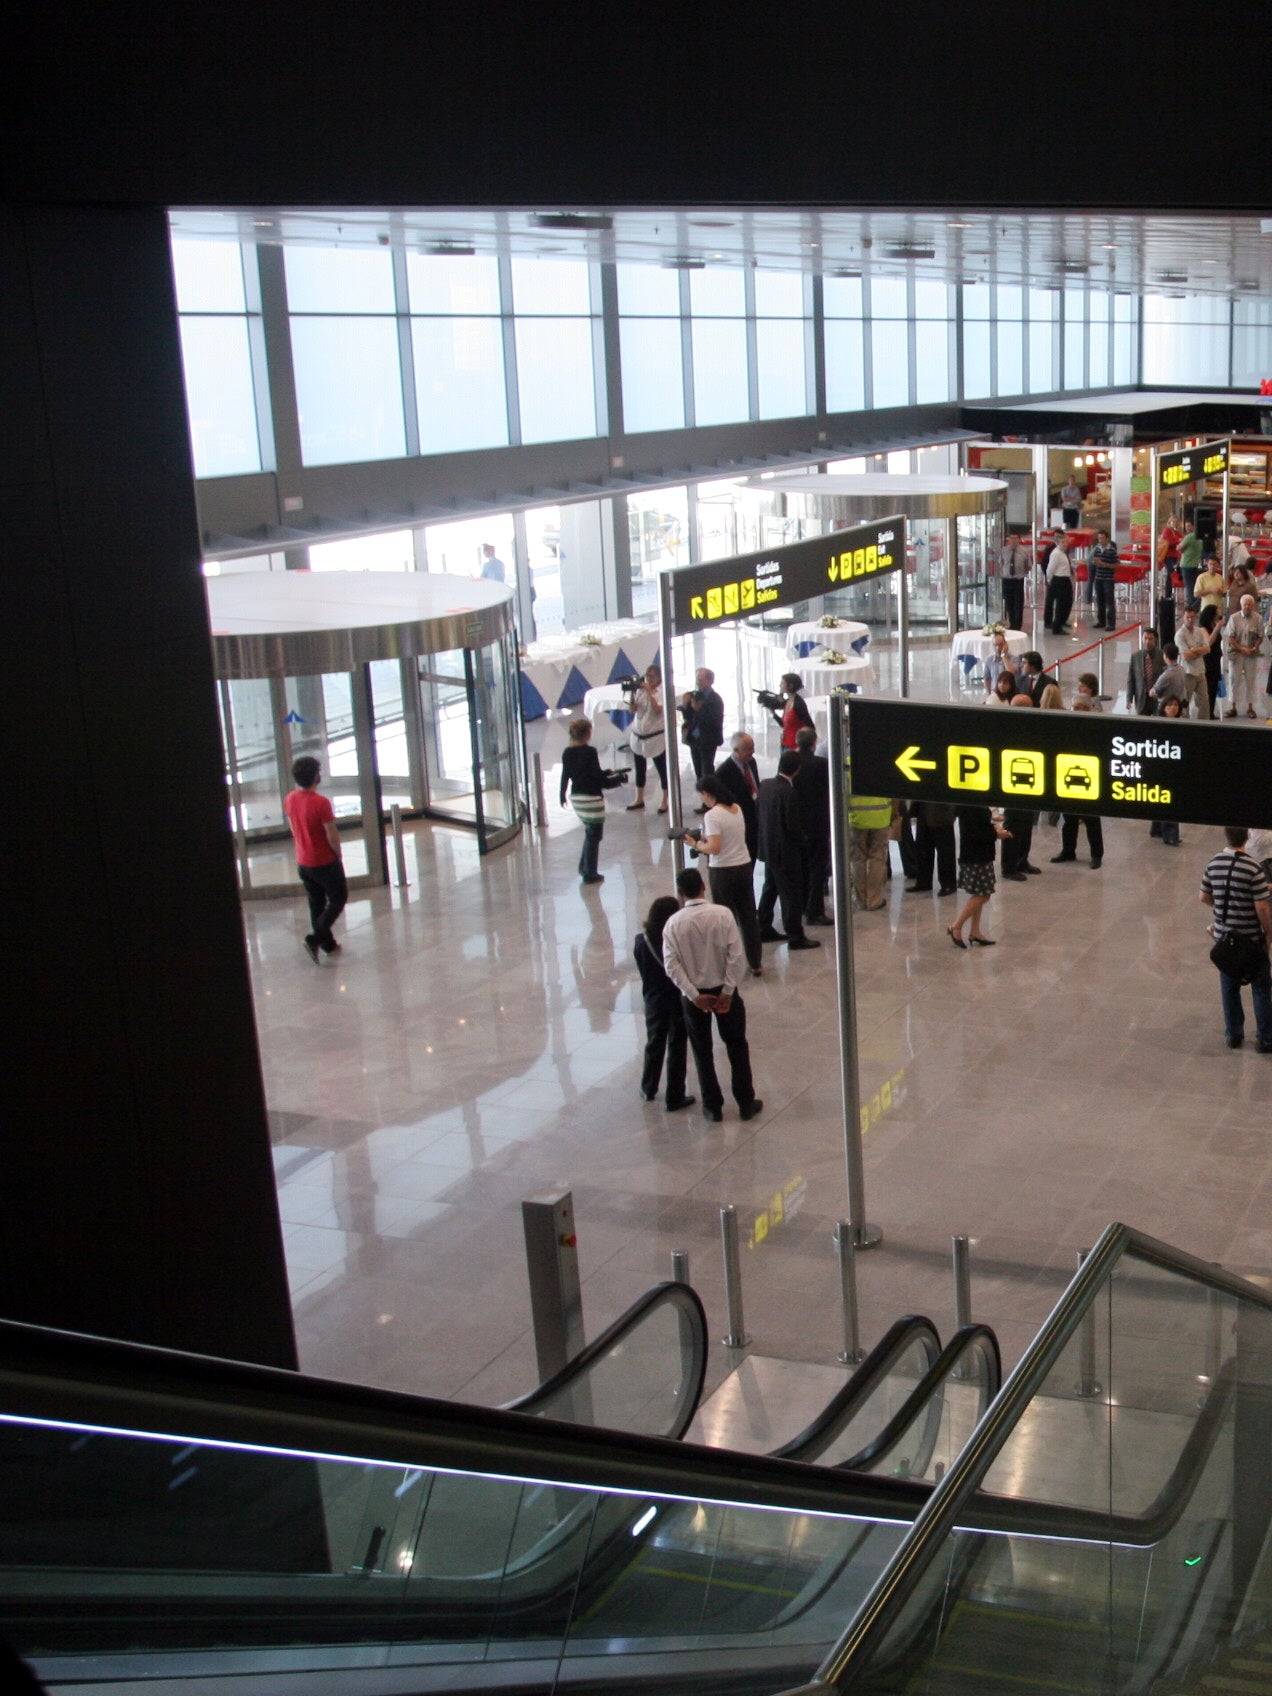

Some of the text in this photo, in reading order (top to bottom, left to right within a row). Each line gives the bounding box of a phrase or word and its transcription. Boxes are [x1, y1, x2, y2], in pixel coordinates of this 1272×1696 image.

[1110, 736, 1182, 762] Sortida
[1110, 759, 1142, 779] Exit
[1110, 780, 1172, 804] Salida
